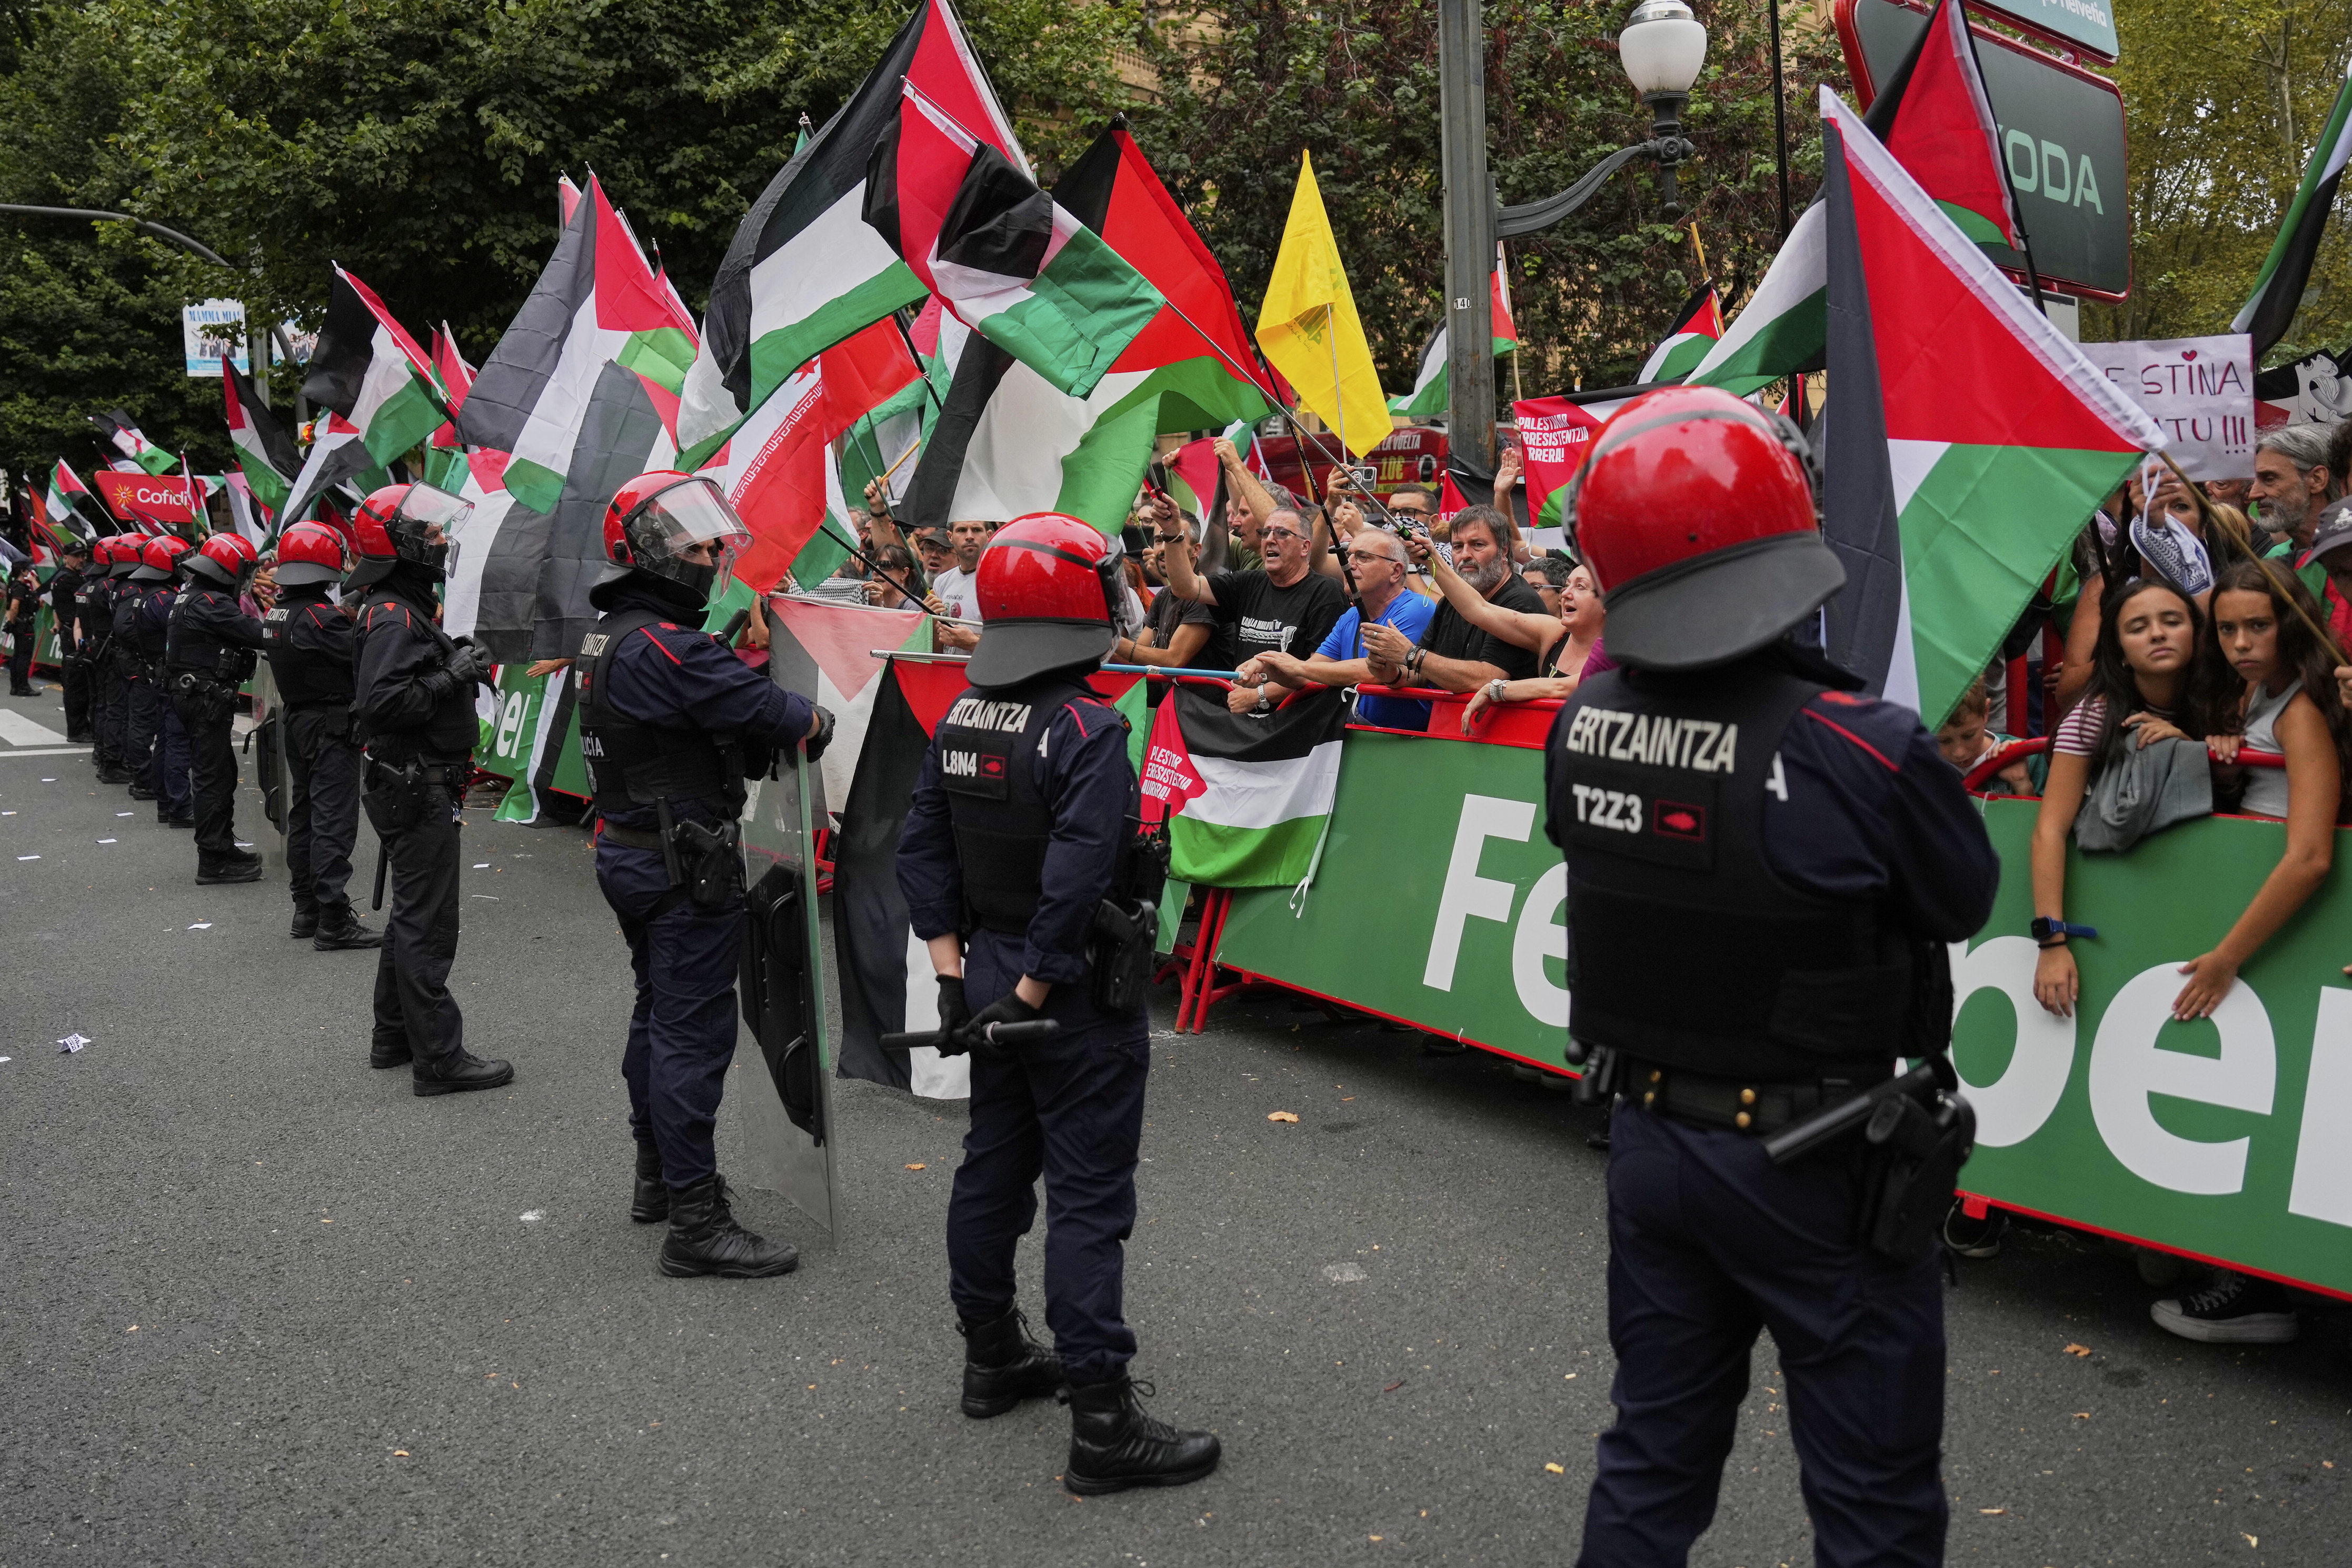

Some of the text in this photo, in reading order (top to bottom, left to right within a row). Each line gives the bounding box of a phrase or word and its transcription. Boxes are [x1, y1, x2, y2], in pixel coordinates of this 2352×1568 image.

[1997, 124, 2104, 215] ODA
[1454, 298, 1471, 308] 140
[188, 310, 220, 323] MAMMA
[1381, 435, 1392, 451] LA
[1392, 434, 1421, 451] VUELTA
[1521, 426, 1589, 446] RRESISTENTZIA
[1380, 455, 1405, 480] 10€
[1527, 447, 1564, 463] RRERA!
[1304, 460, 1317, 486] ADVENTURE
[137, 488, 190, 506] Cofidi
[946, 698, 1032, 734] ERTZAINTZA
[1566, 705, 1738, 774] ERTZAINTZA
[943, 750, 977, 777] L8N4
[1572, 783, 1643, 834] T2Z3
